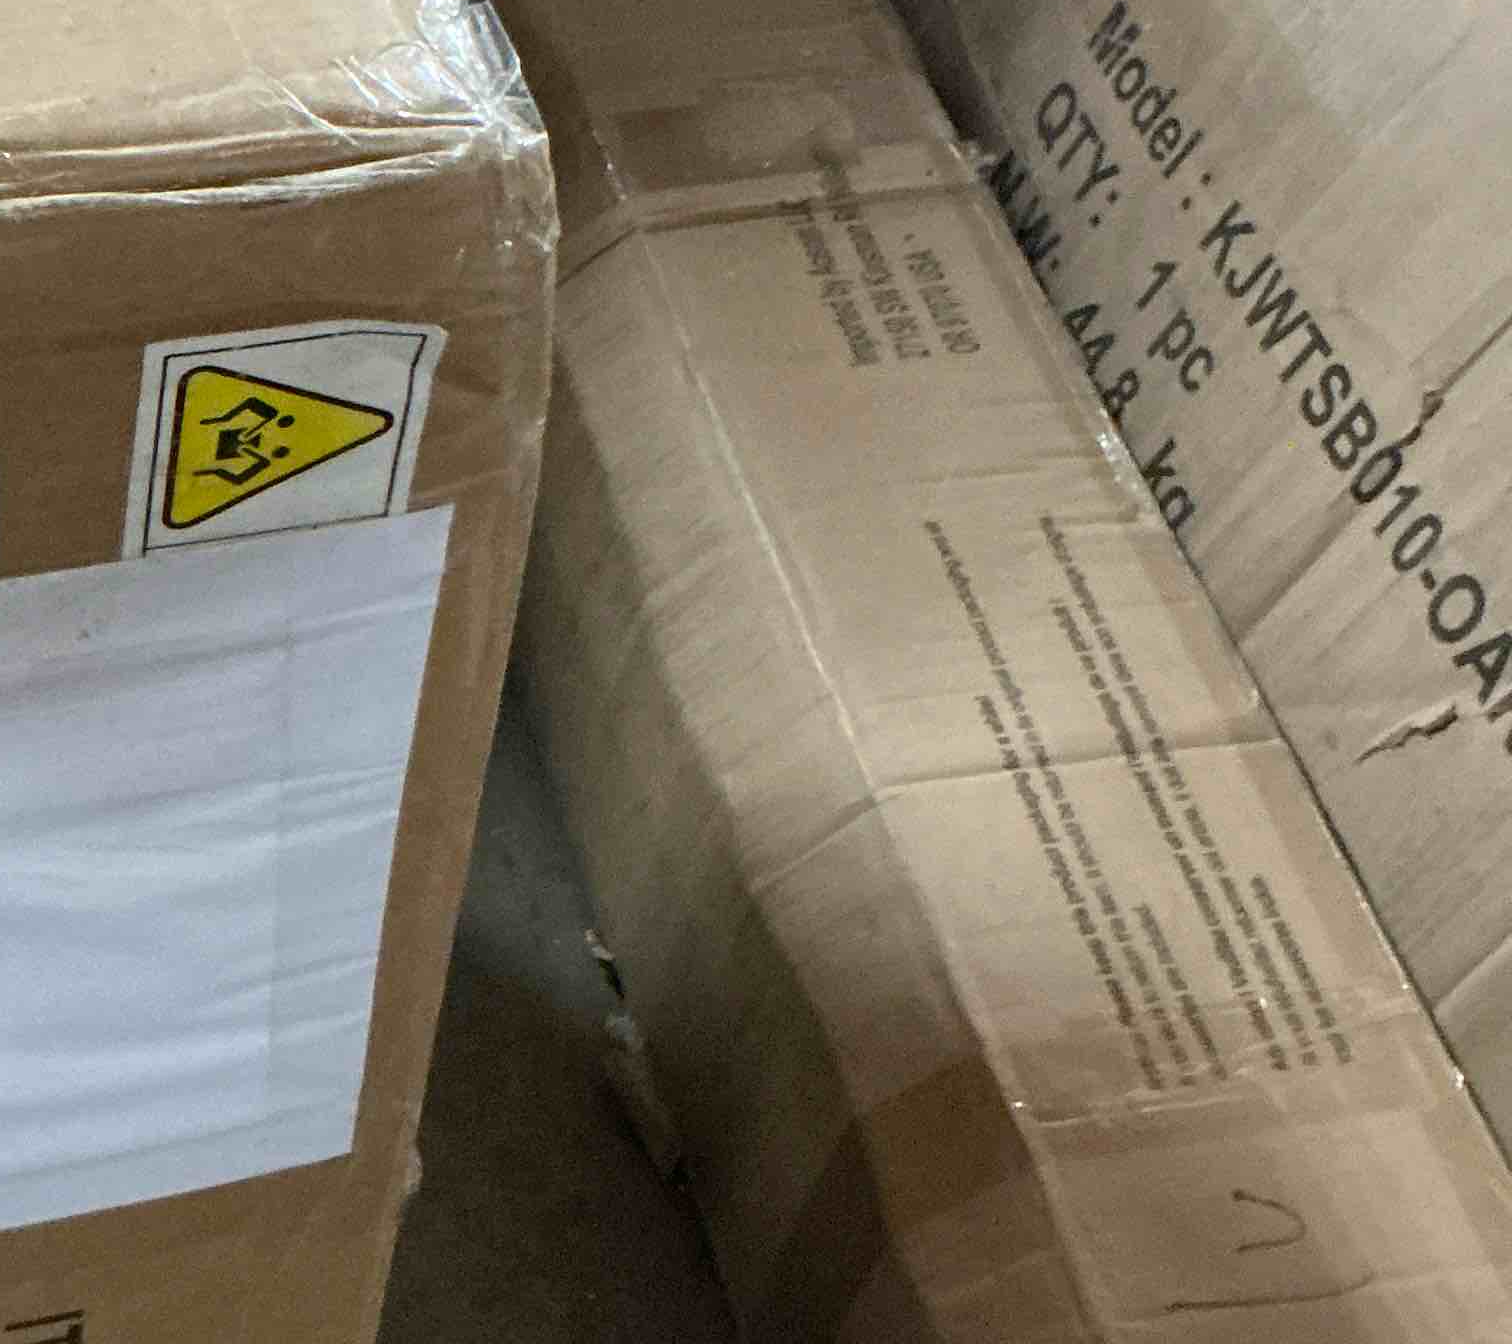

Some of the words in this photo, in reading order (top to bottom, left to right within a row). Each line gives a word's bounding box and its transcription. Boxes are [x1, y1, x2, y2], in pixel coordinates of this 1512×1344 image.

[1090, 0, 1205, 180] Model
[1033, 80, 1120, 228] QTY:
[1135, 259, 1178, 310] 1
[1147, 308, 1215, 393] pc
